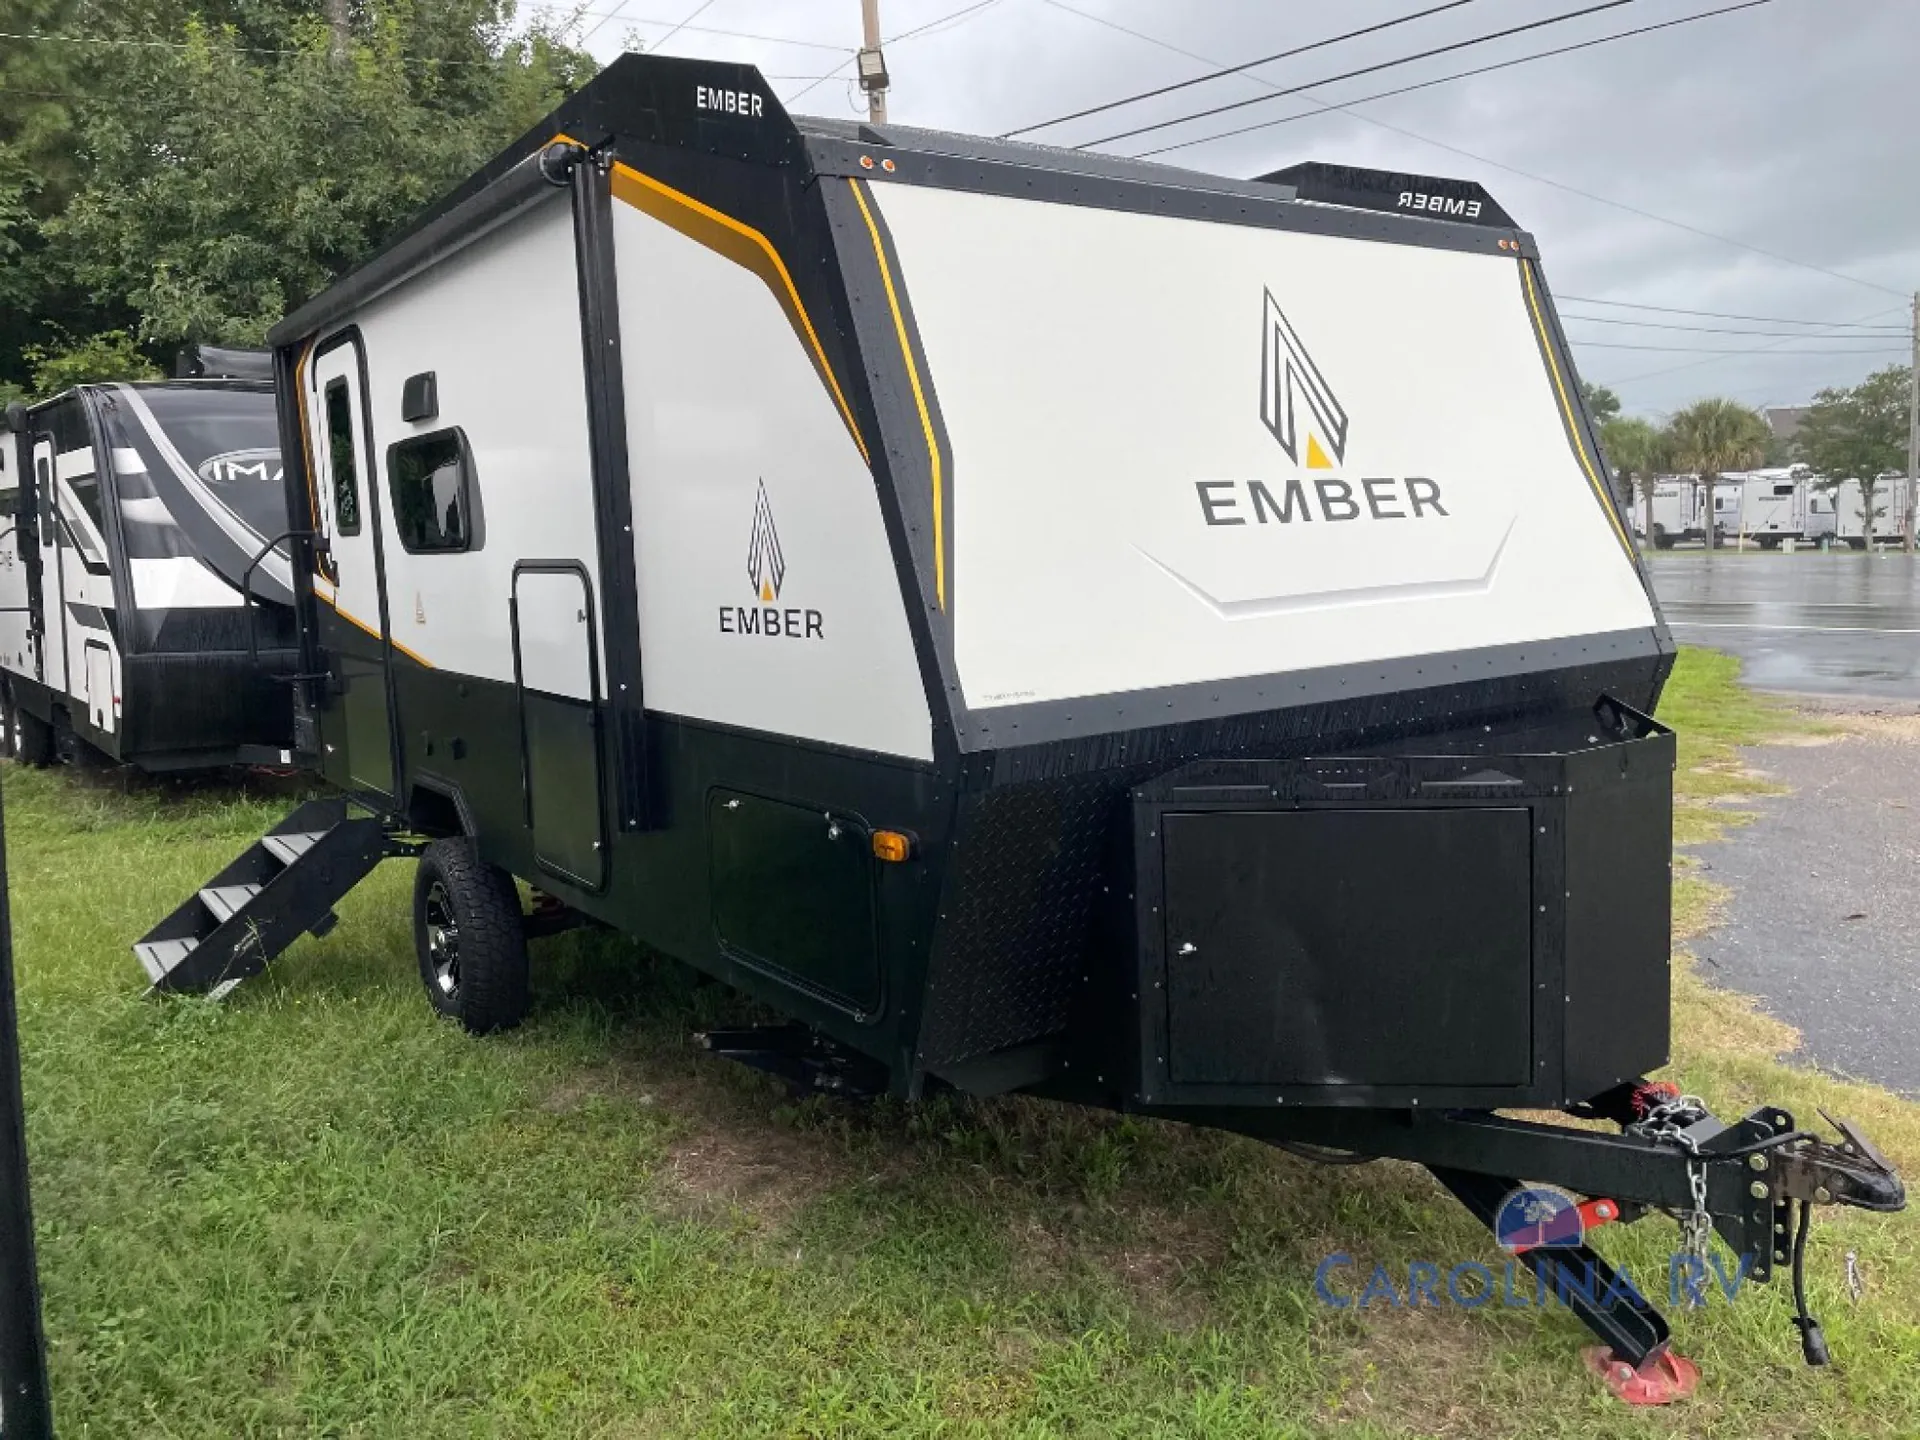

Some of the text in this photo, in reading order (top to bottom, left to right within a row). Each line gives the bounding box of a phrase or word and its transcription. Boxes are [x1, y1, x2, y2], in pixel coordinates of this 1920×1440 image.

[696, 85, 763, 117] EMBER
[1195, 477, 1450, 526] EMBER
[719, 606, 824, 639] EMBER
